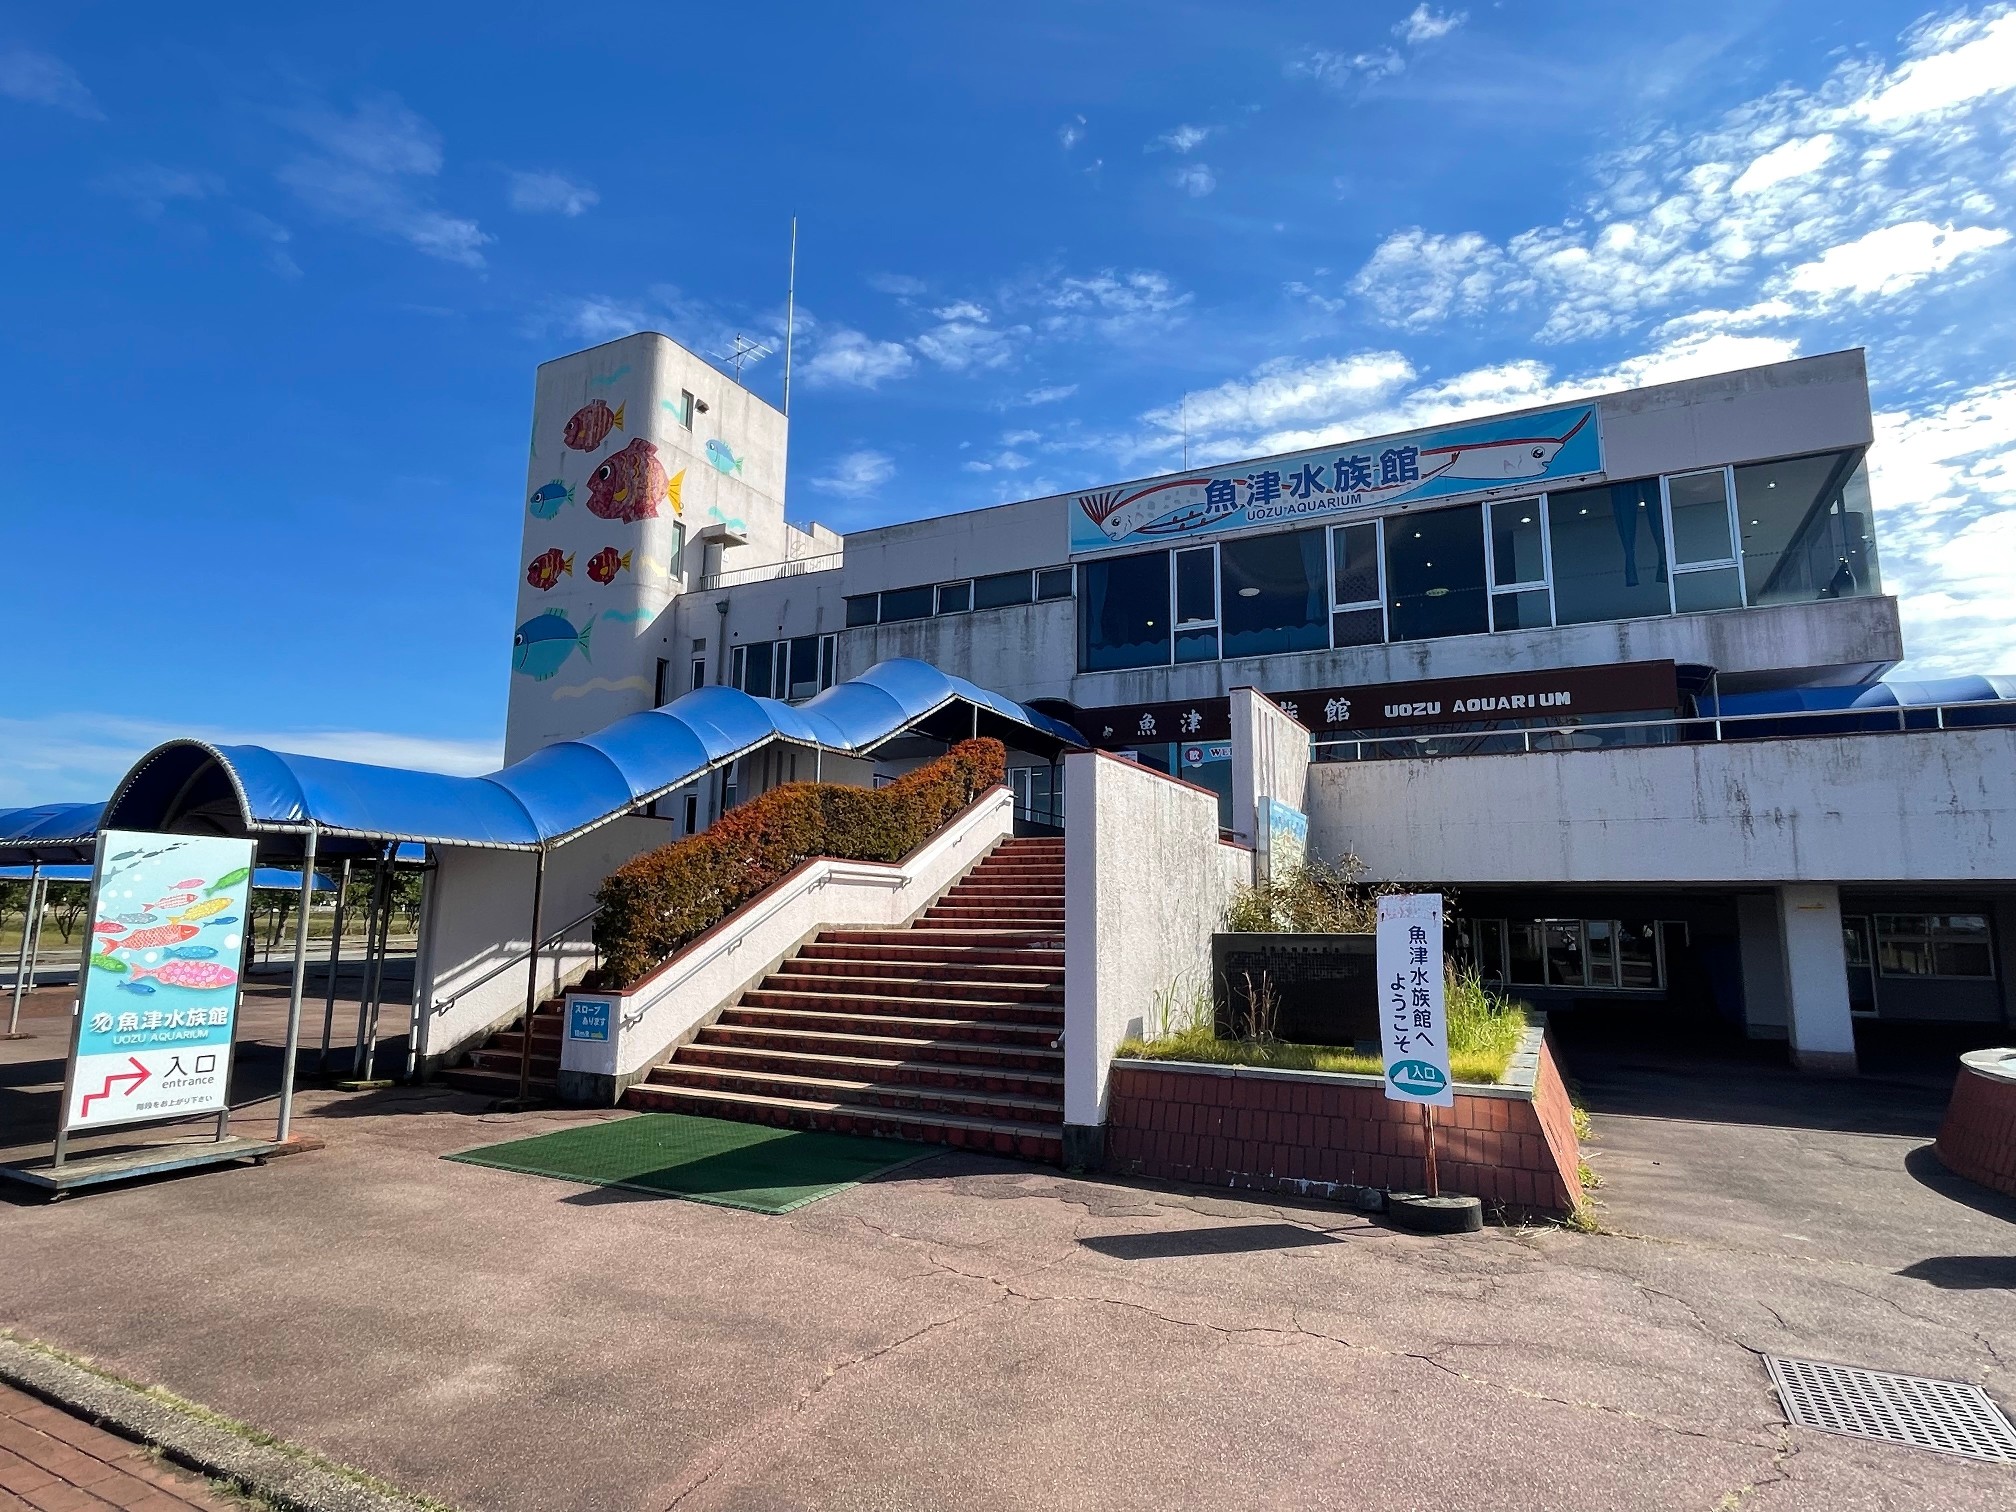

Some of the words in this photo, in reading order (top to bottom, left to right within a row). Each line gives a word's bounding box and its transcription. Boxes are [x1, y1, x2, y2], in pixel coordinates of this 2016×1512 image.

[1205, 446, 1419, 514] 魚津水族館
[1247, 507, 1283, 521] UOZU
[1288, 493, 1361, 517] AQUARIUM
[1137, 697, 1351, 736] 魚津族館
[1384, 702, 1441, 718] UOZU
[1453, 691, 1571, 713] AQUARIUM
[1408, 925, 1435, 1047] 魚津水族館へ
[116, 1006, 229, 1033] 魚津水族館
[582, 1016, 606, 1026] あります
[1390, 973, 1411, 1054] ようこそ
[113, 1034, 147, 1045] UOZU
[150, 1029, 209, 1042] AQUARIUM
[164, 1054, 216, 1078] 入口
[1411, 1064, 1436, 1081] 入口
[162, 1075, 215, 1089] entrance
[136, 1095, 213, 1111] 階段をお上がり下さい
